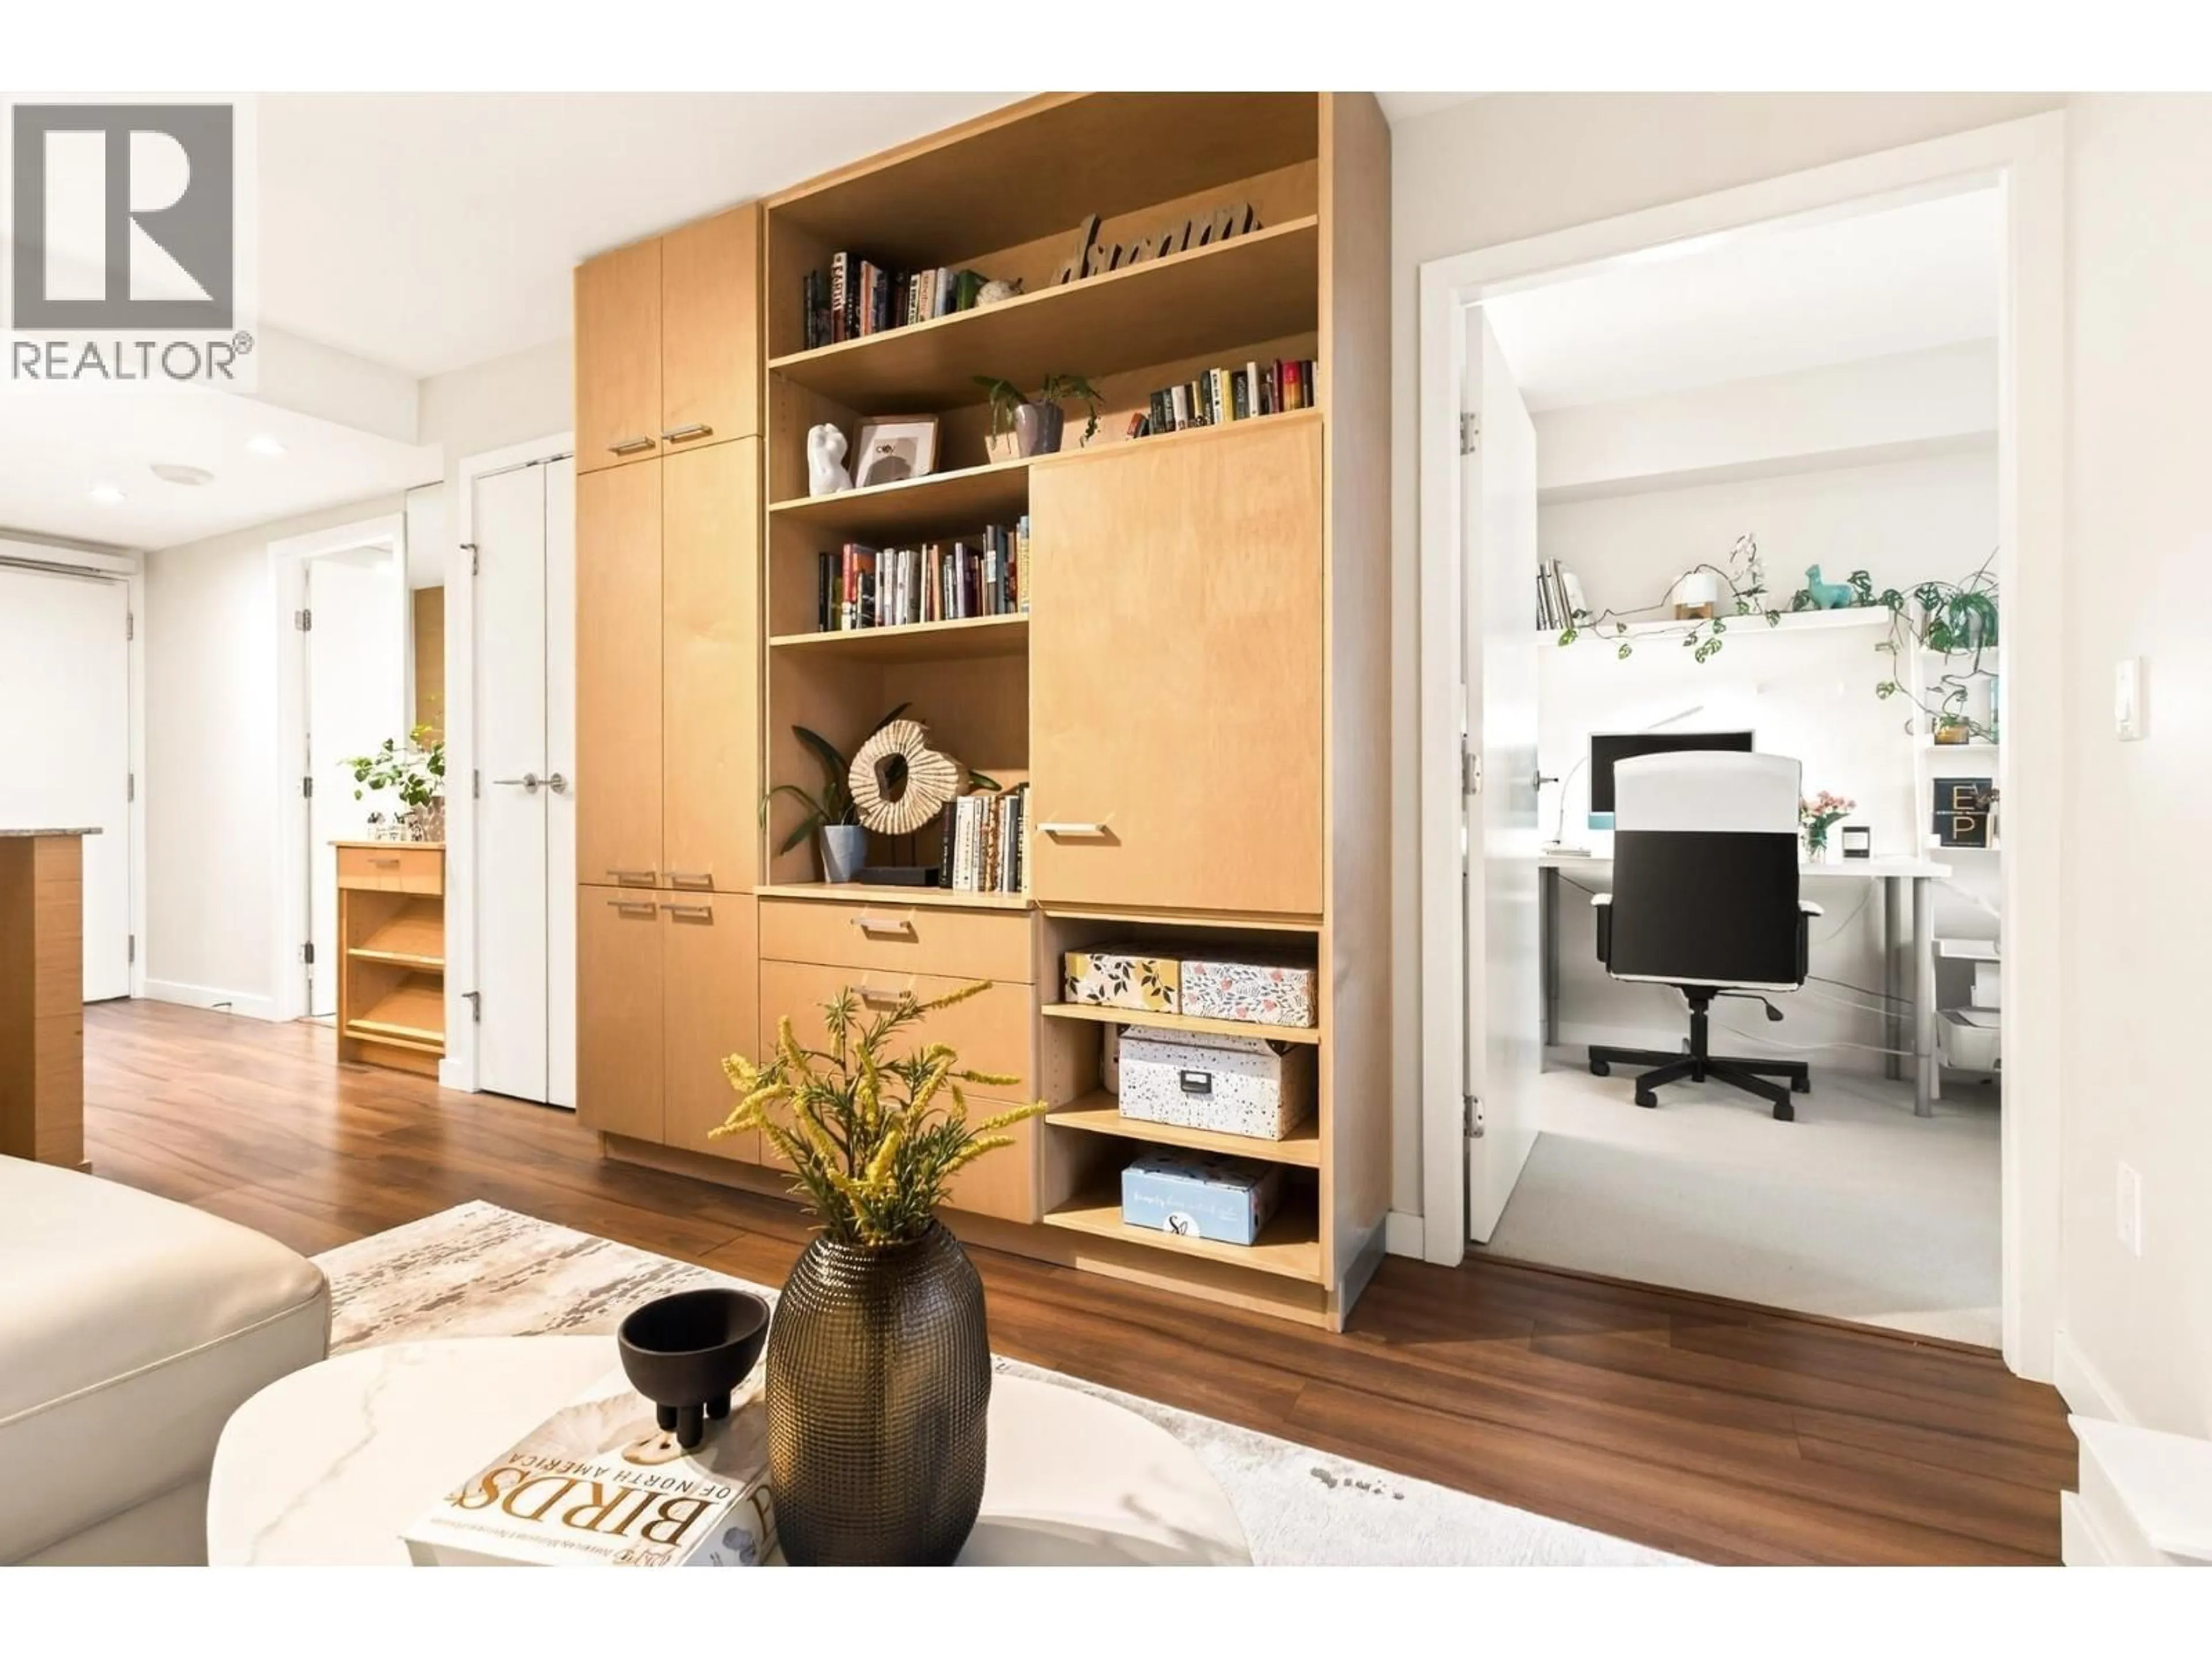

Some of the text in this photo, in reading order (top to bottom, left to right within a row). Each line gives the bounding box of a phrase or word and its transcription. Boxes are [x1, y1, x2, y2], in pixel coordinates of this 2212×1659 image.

[1953, 785, 1976, 810] E
[1953, 816, 1976, 839] P
[509, 1453, 732, 1499] OF NORTH AMERICA
[447, 1466, 721, 1548] BIRDS
